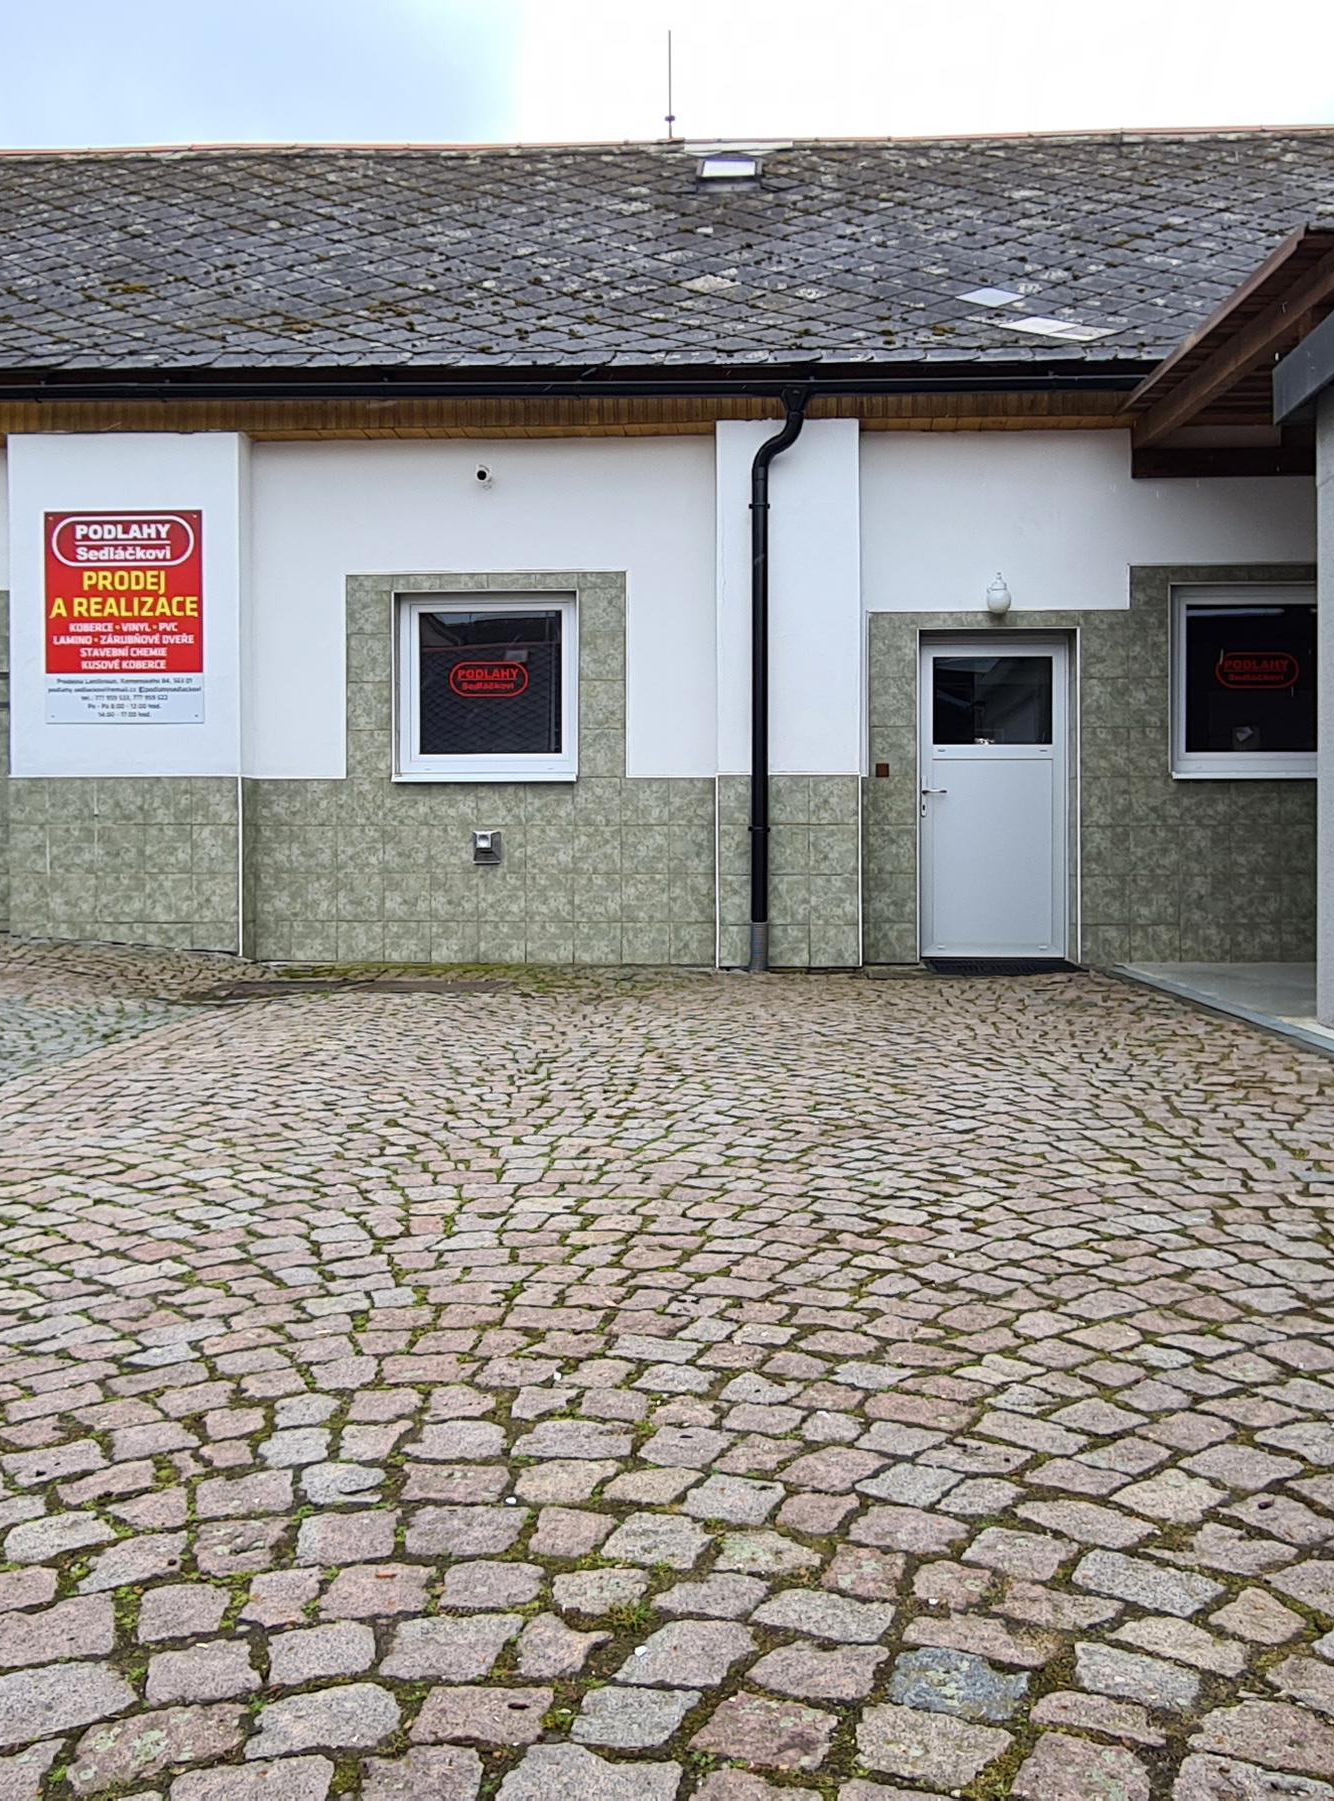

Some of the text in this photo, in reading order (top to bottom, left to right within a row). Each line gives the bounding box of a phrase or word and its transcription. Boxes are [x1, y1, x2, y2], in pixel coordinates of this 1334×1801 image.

[75, 524, 171, 540] PODLAHY
[76, 546, 171, 561] Sedláčkovi
[82, 571, 166, 594] PRODEJ
[49, 596, 199, 619] A REALIZACE
[69, 622, 179, 632] KOBERCE VINYL PVC
[53, 636, 92, 646] LAMINO
[162, 634, 195, 644] DVEŘE
[80, 646, 167, 658] STAVEBNÍ CHEMIE
[81, 659, 167, 670] KUSOVÉ KOBERCE
[1223, 660, 1289, 670] PODLAHY
[457, 668, 519, 679] PODLAHY
